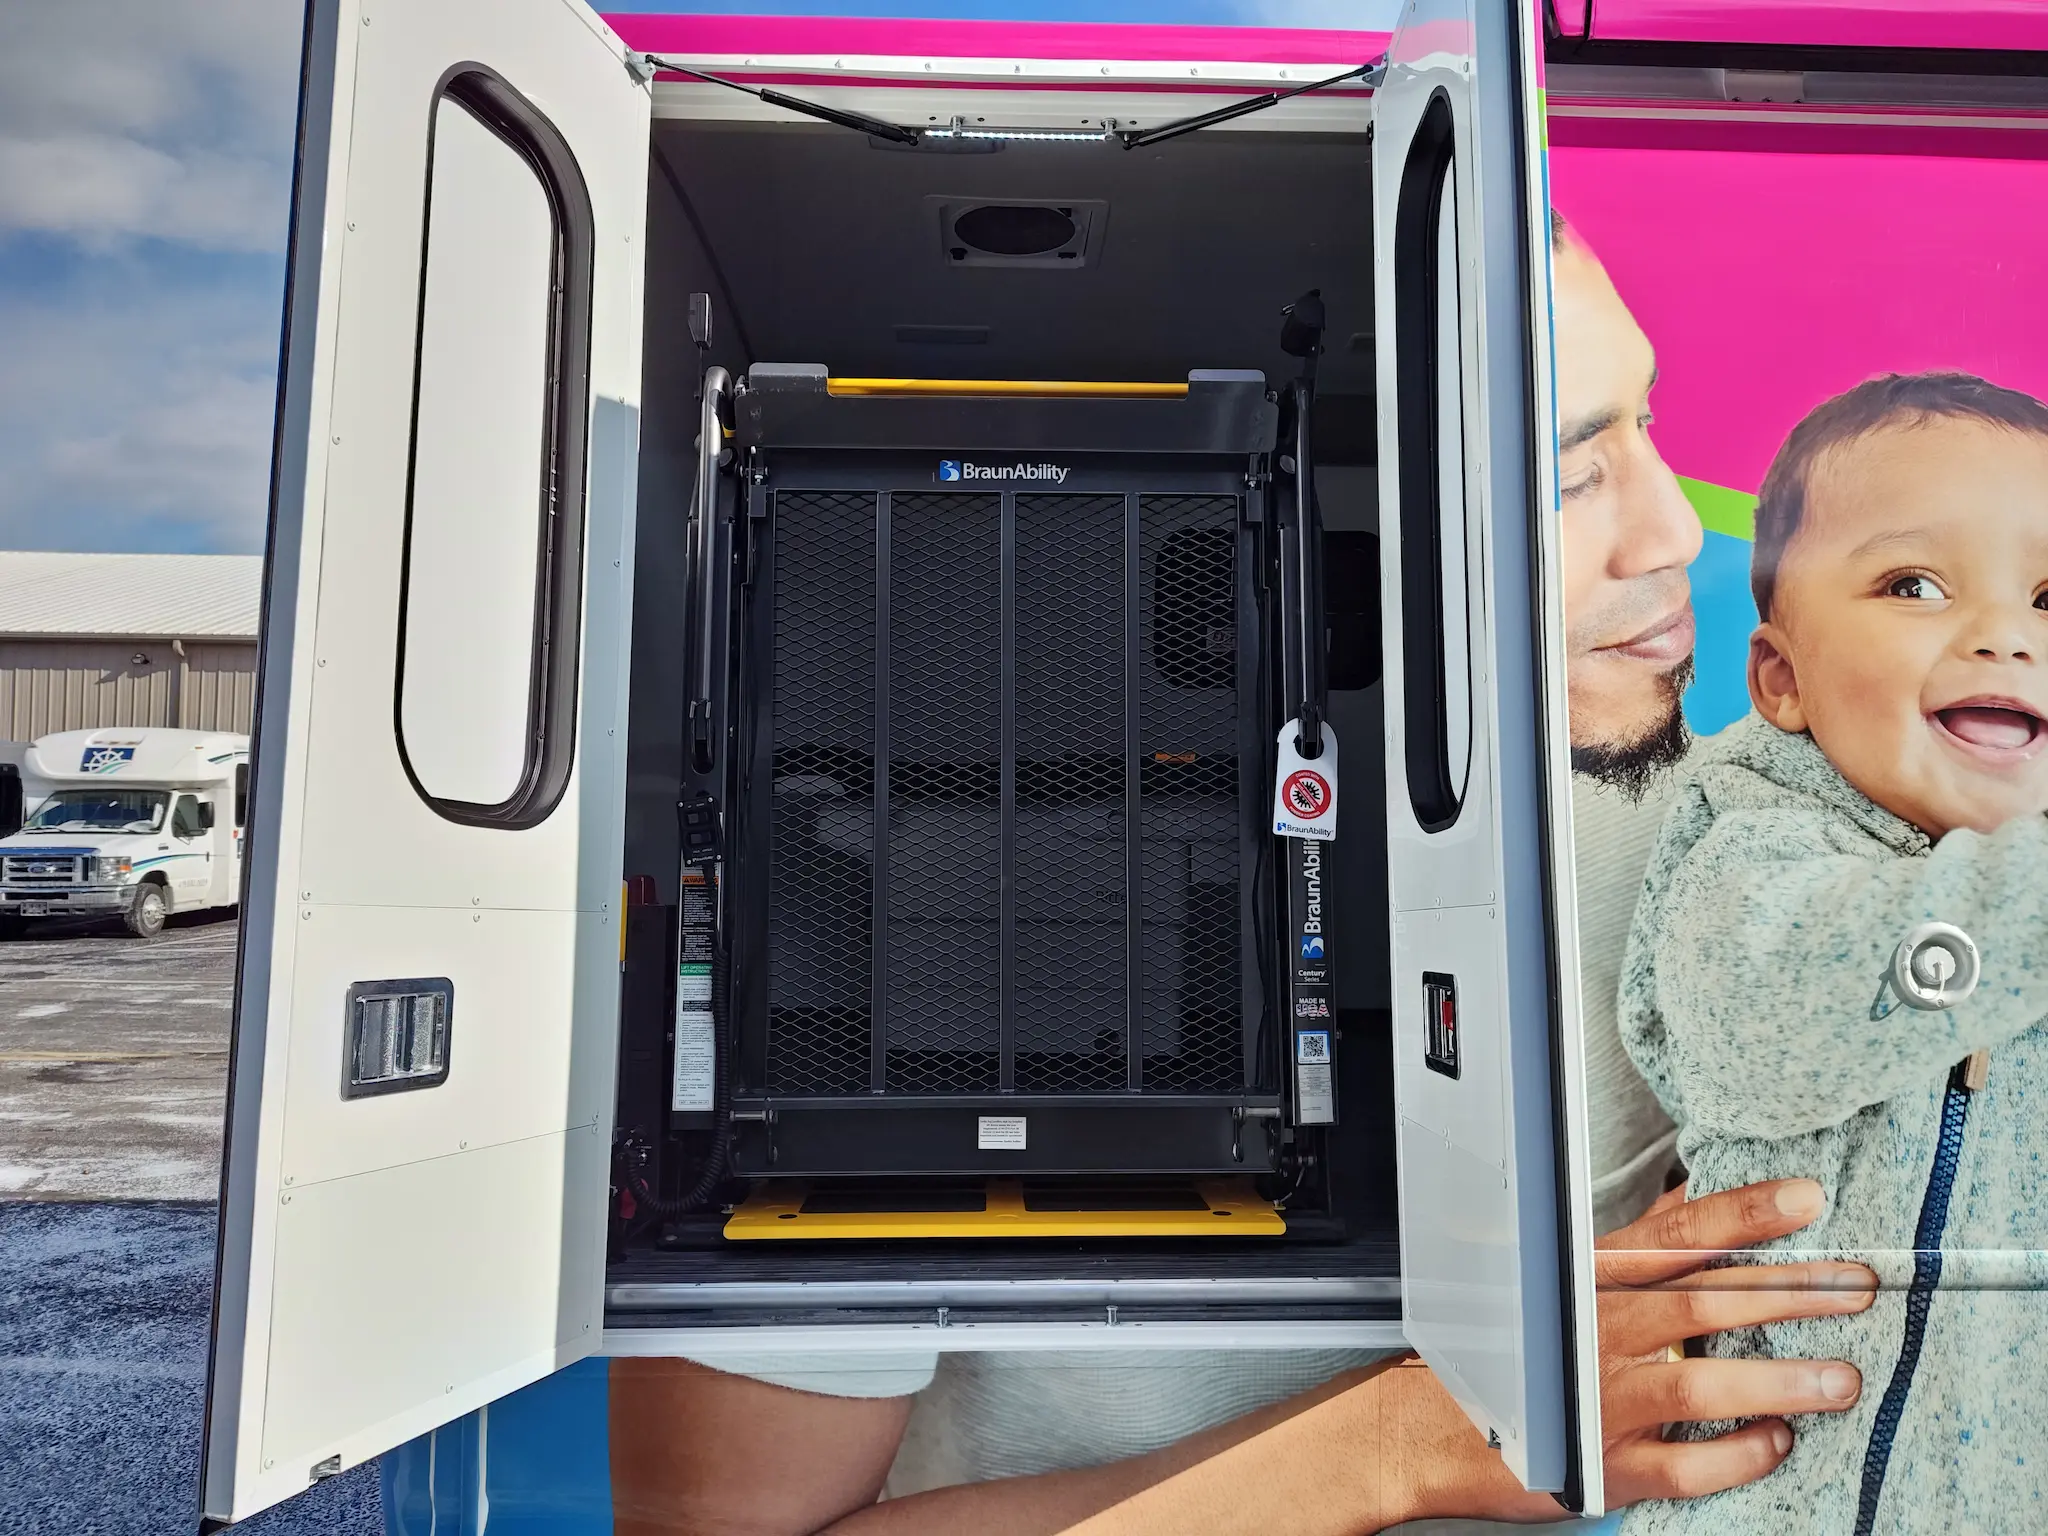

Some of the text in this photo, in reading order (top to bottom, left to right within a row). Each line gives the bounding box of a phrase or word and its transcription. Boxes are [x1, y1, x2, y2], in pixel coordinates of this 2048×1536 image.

[963, 462, 1070, 484] BraunAbility
[1287, 824, 1333, 837] BraunAbility
[1303, 838, 1321, 934] BraunAbili
[1298, 969, 1326, 977] Century
[1295, 1003, 1330, 1017] USA
